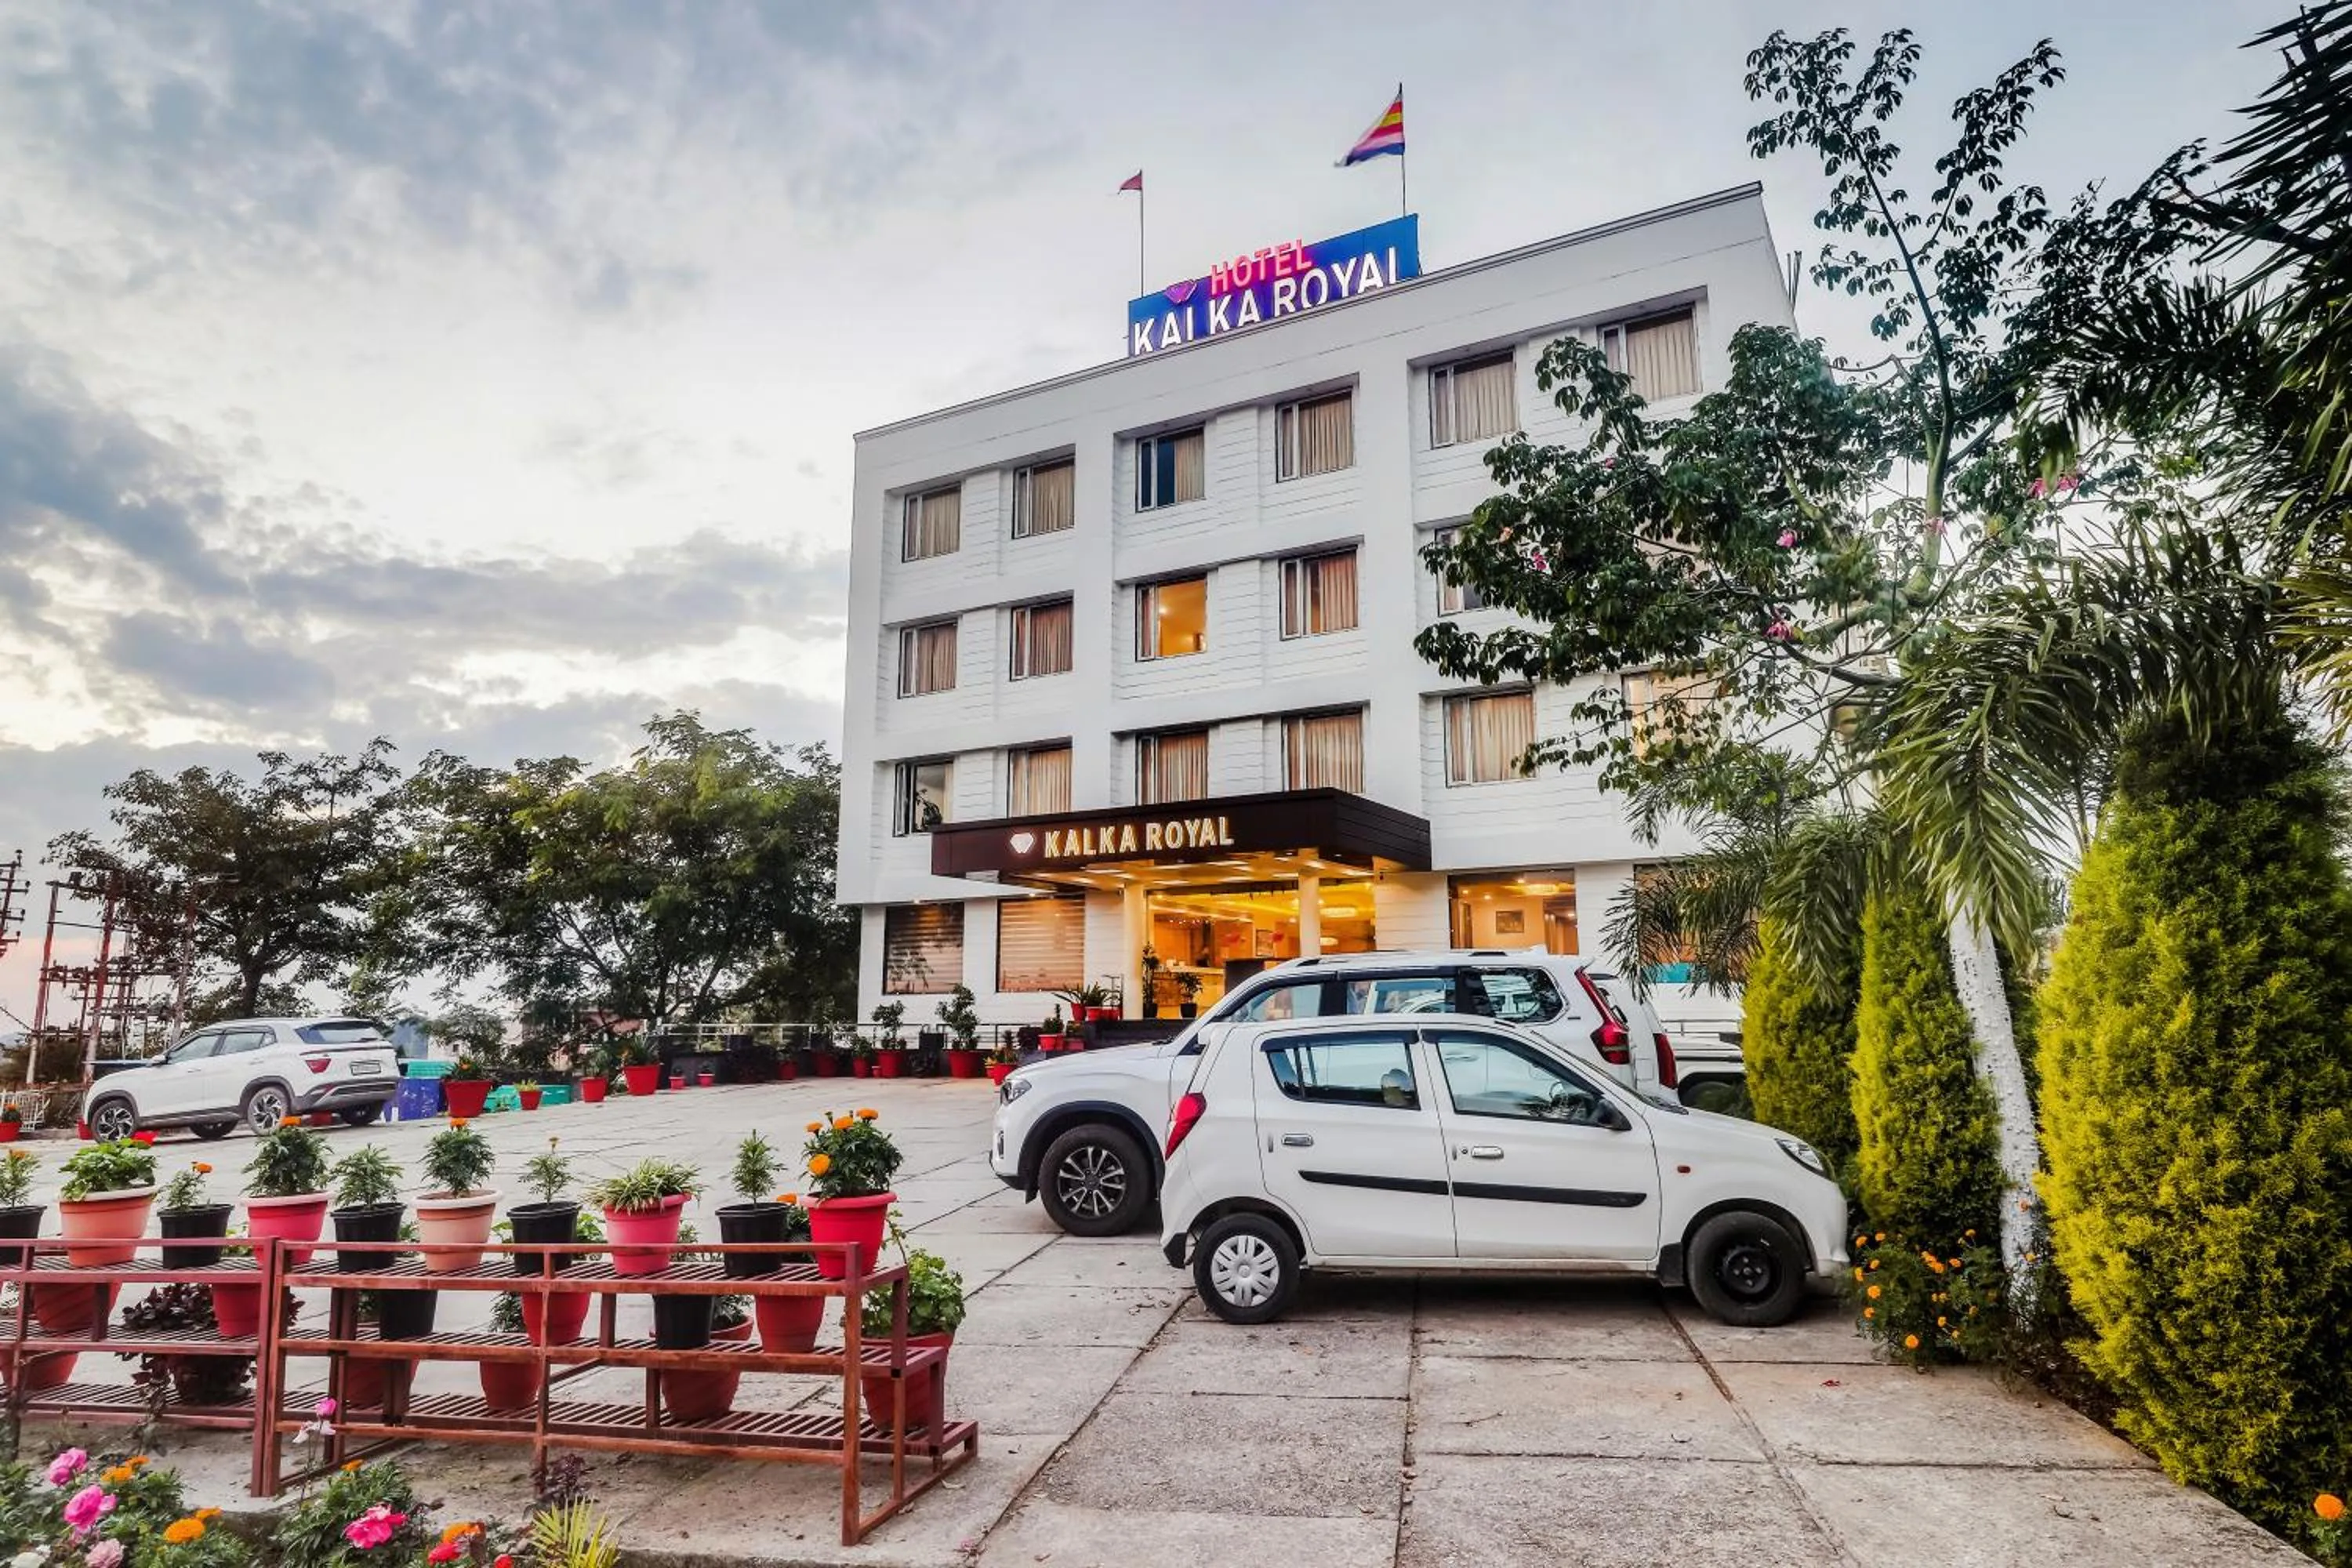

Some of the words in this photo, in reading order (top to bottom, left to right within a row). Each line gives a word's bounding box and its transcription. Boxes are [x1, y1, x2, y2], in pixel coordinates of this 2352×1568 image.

[1210, 238, 1312, 296] HOTEL
[1044, 824, 1138, 858] KALKA
[1145, 816, 1235, 851] ROYAL
